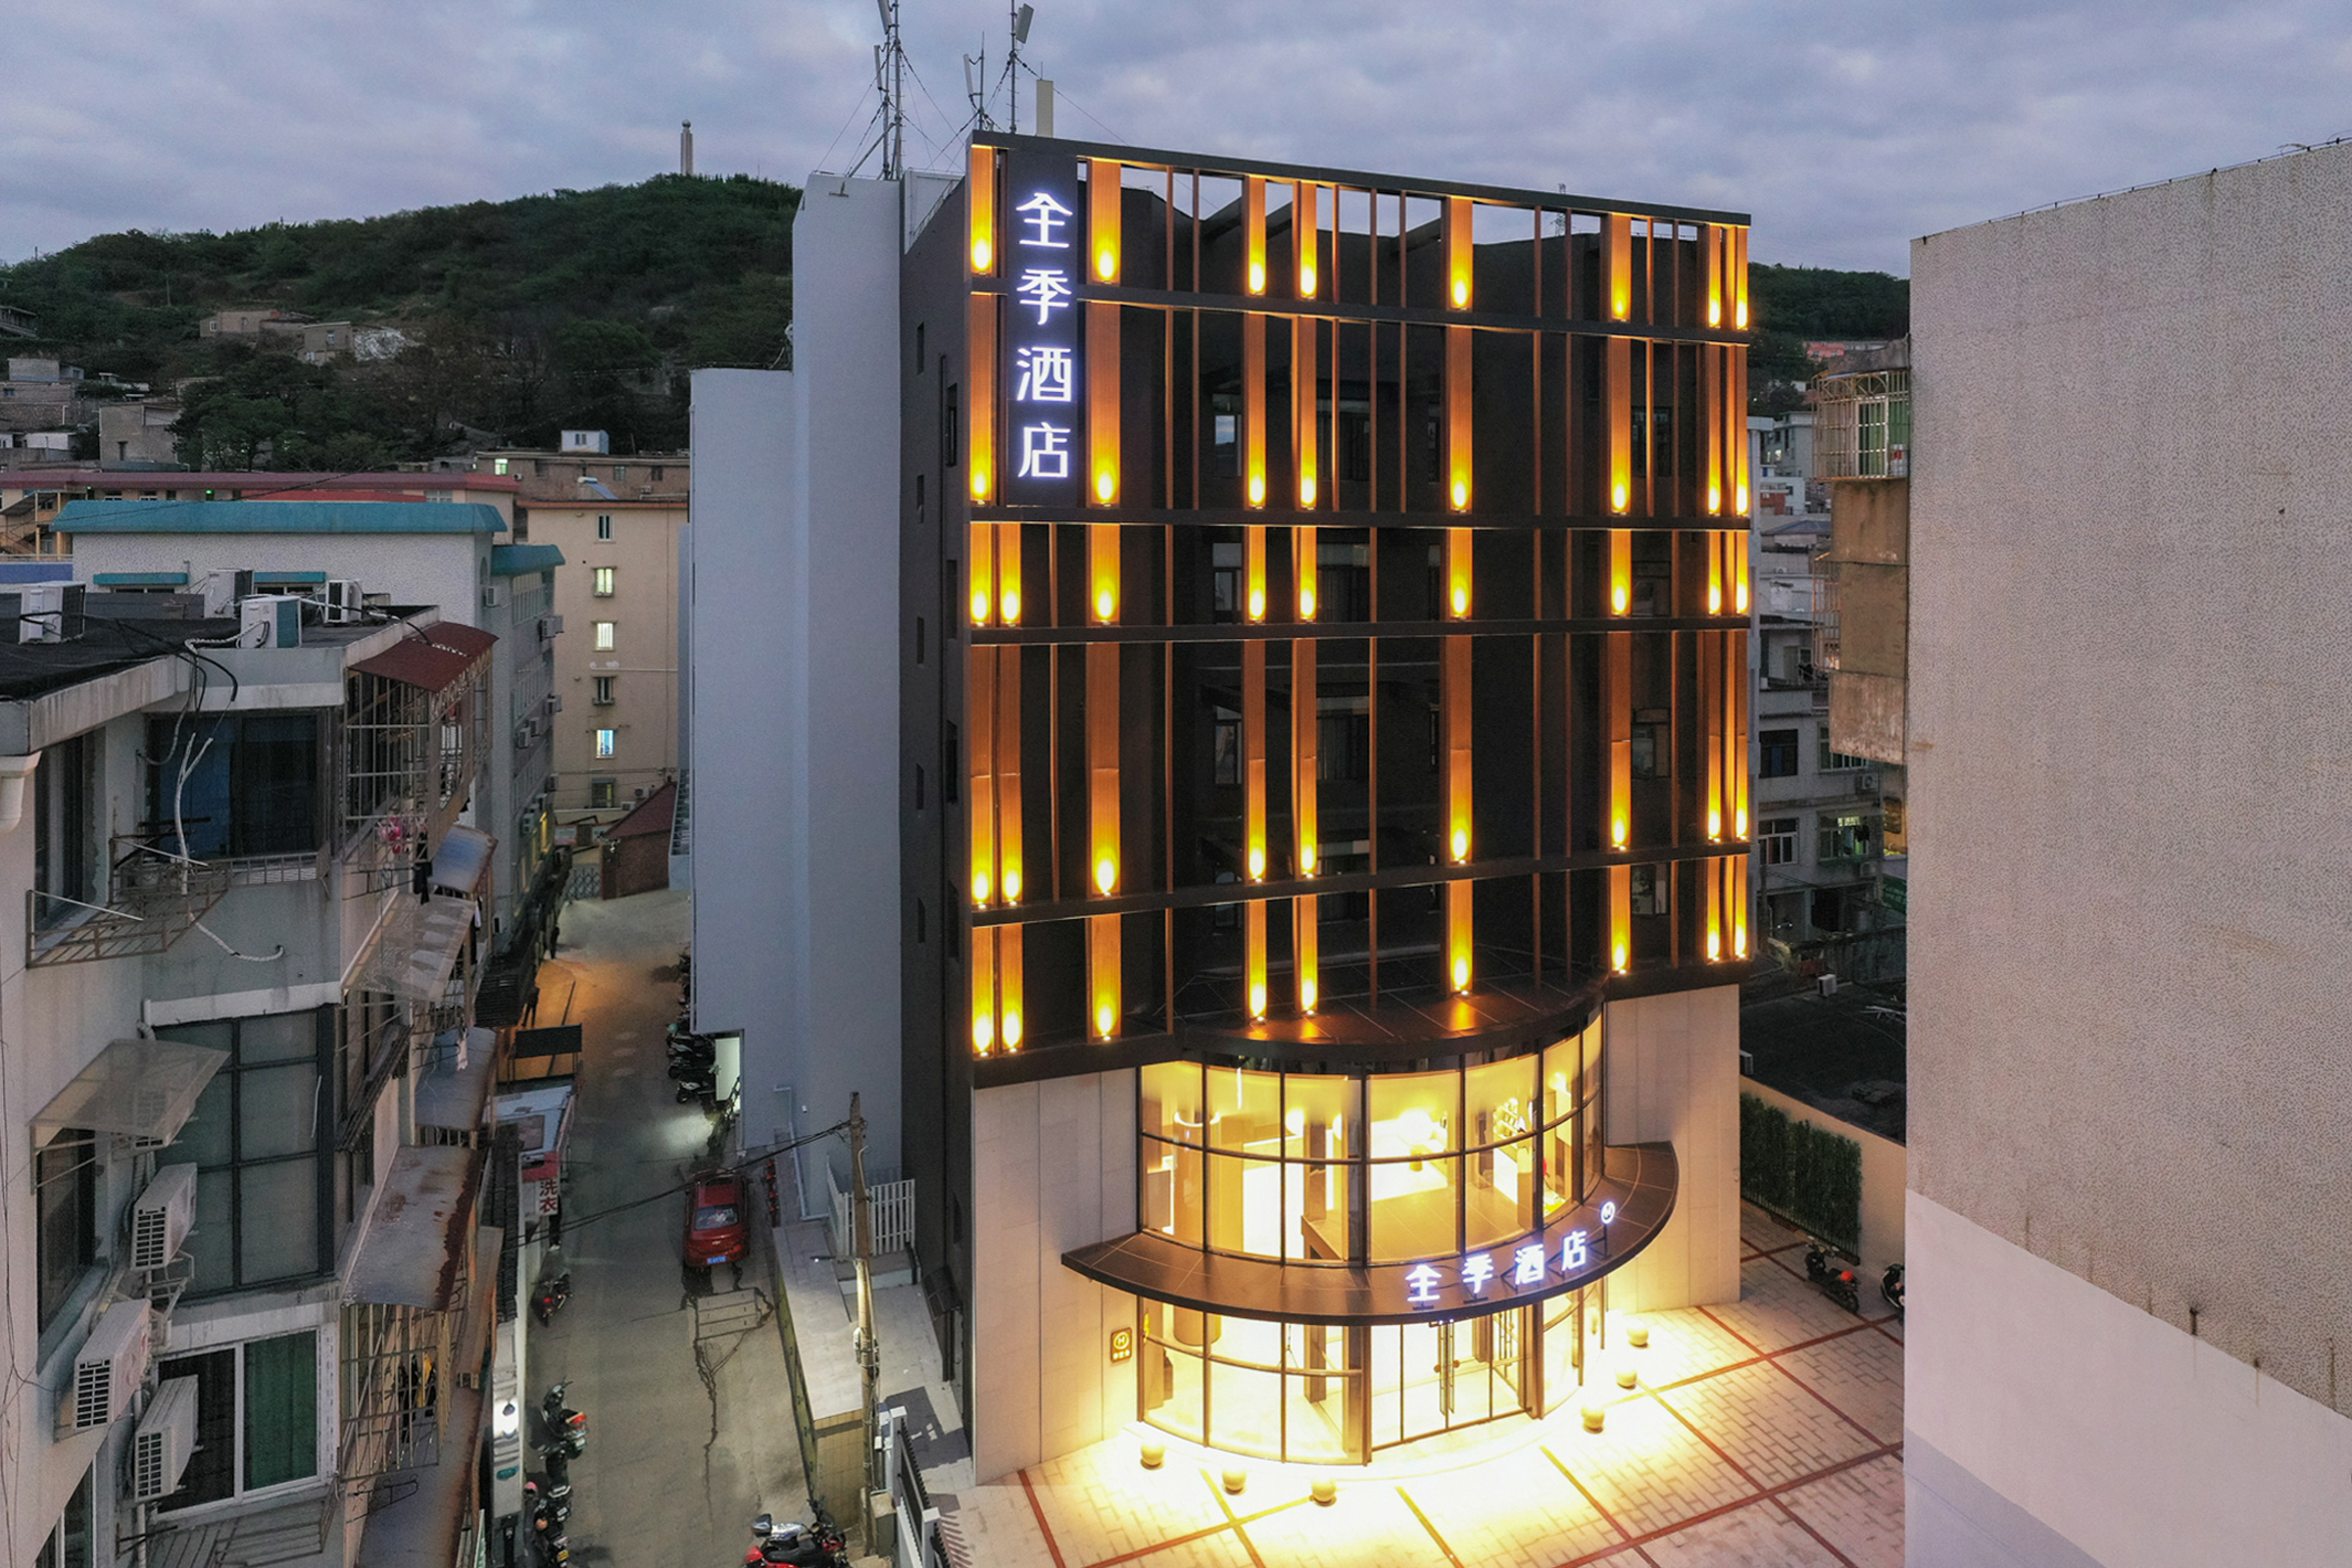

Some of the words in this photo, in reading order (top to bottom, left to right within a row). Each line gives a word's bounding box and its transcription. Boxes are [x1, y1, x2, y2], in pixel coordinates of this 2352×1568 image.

[1015, 192, 1073, 478] 全季酒店
[539, 1179, 558, 1213] 洗衣
[1405, 1231, 1587, 1301] 全季酒店
